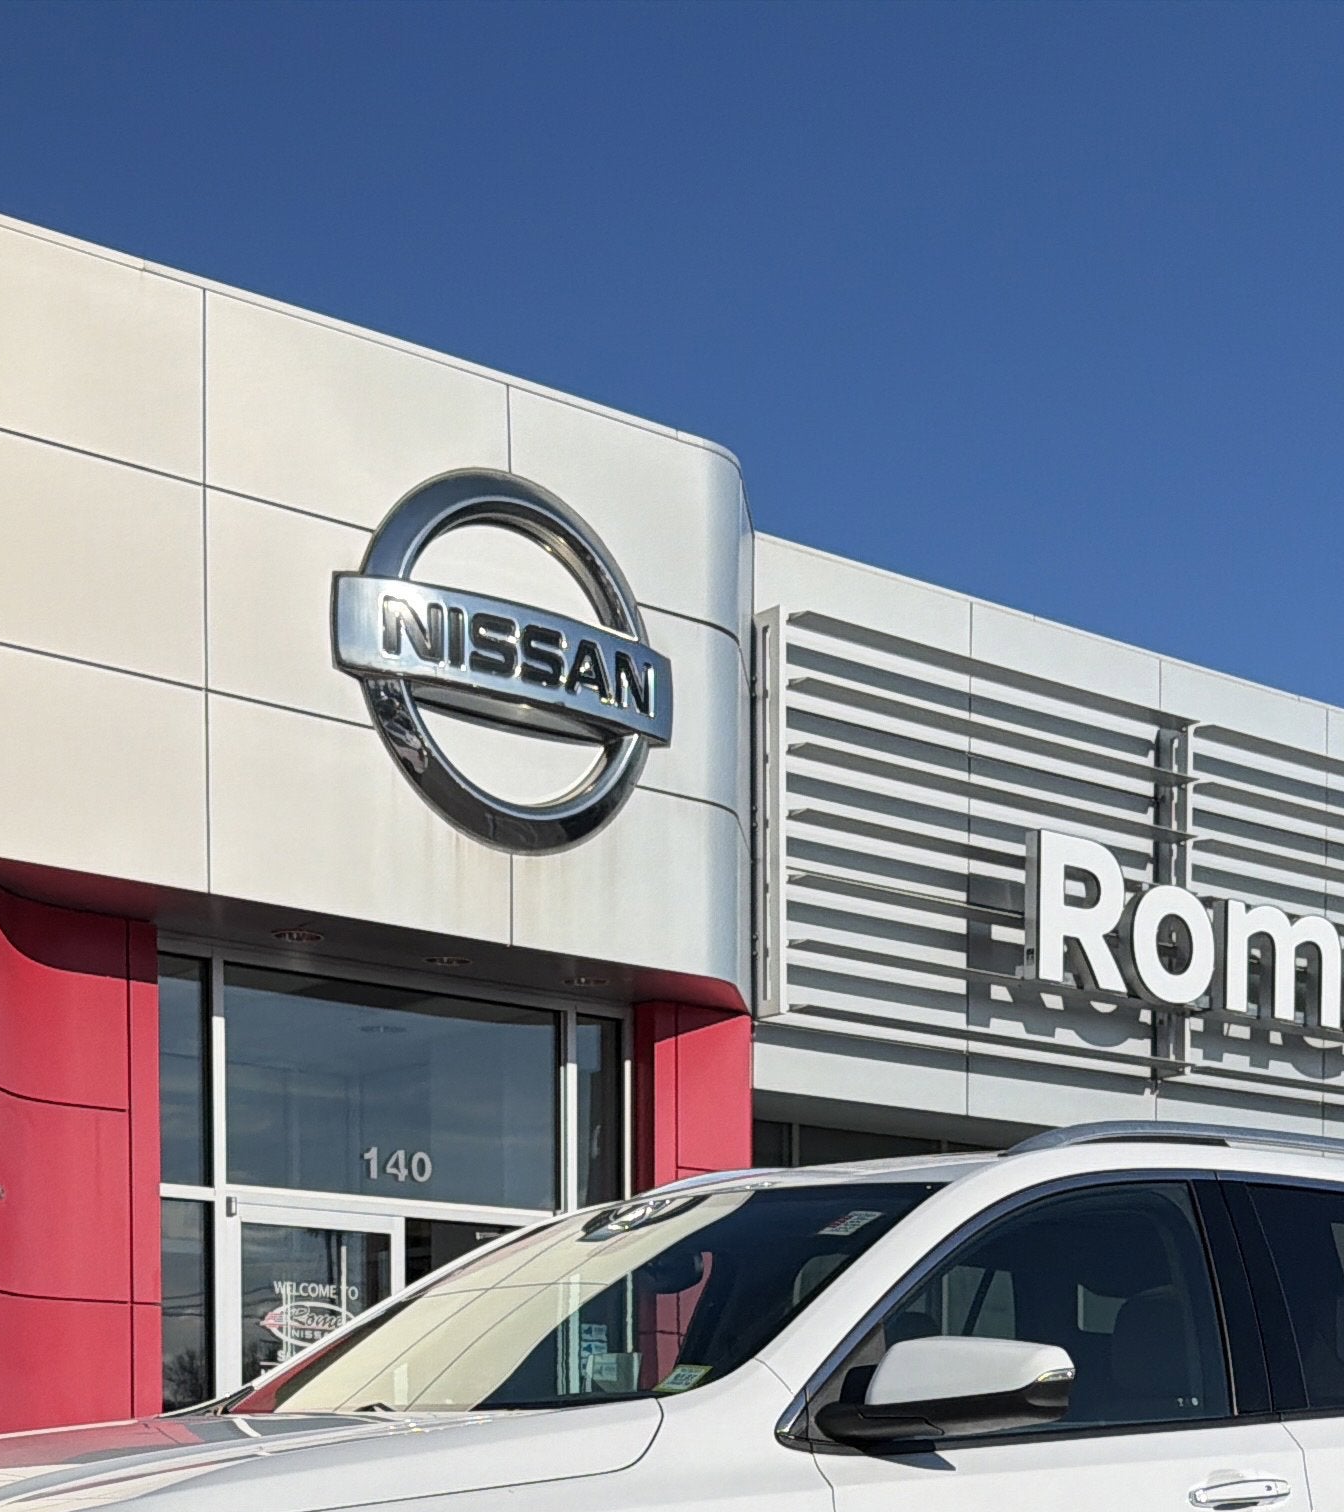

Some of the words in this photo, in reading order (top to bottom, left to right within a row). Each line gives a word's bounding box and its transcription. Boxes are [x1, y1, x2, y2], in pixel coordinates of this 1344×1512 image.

[379, 594, 655, 719] NISSAN
[363, 1146, 432, 1184] 140
[273, 1280, 338, 1299] WELCOME
[288, 1304, 344, 1328] Rome
